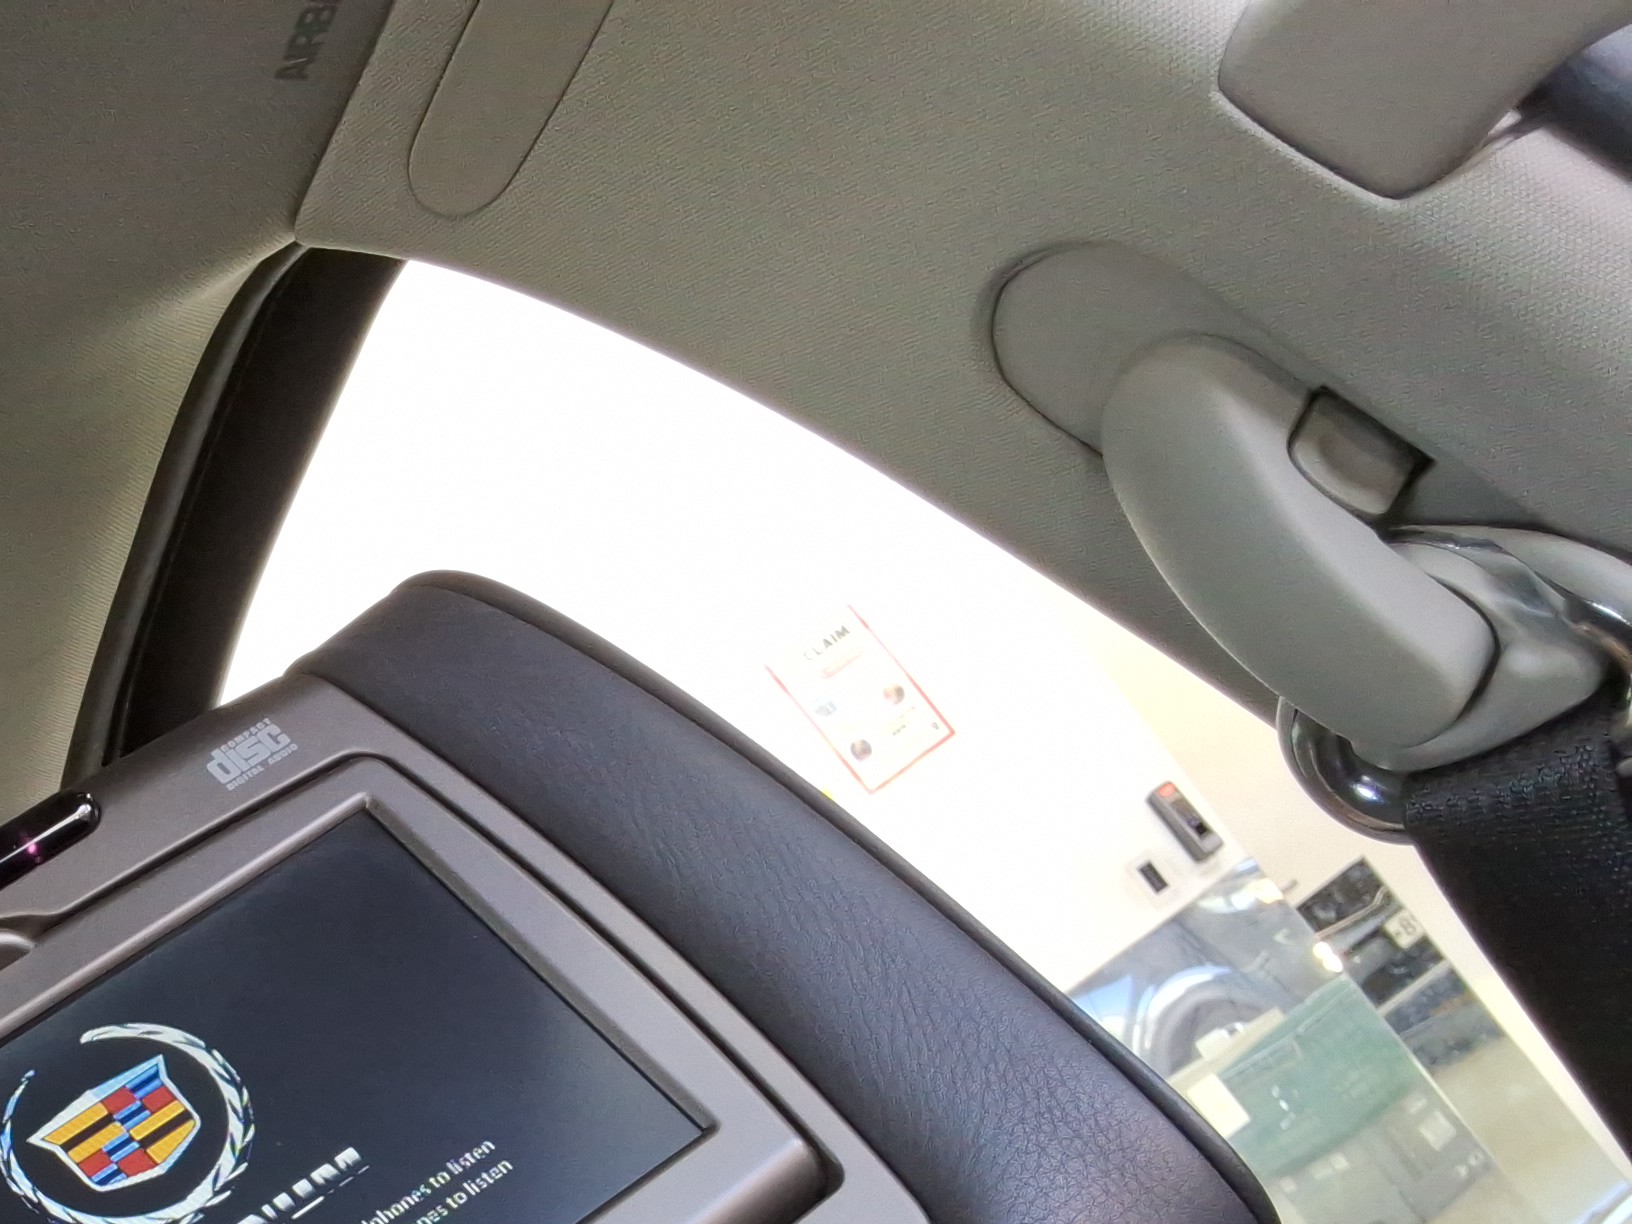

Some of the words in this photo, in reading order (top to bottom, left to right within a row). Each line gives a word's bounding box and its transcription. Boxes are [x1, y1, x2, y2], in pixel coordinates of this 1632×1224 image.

[429, 1169, 451, 1188] to
[446, 1139, 496, 1175] listen
[445, 1190, 467, 1209] to
[463, 1159, 513, 1196] listen
